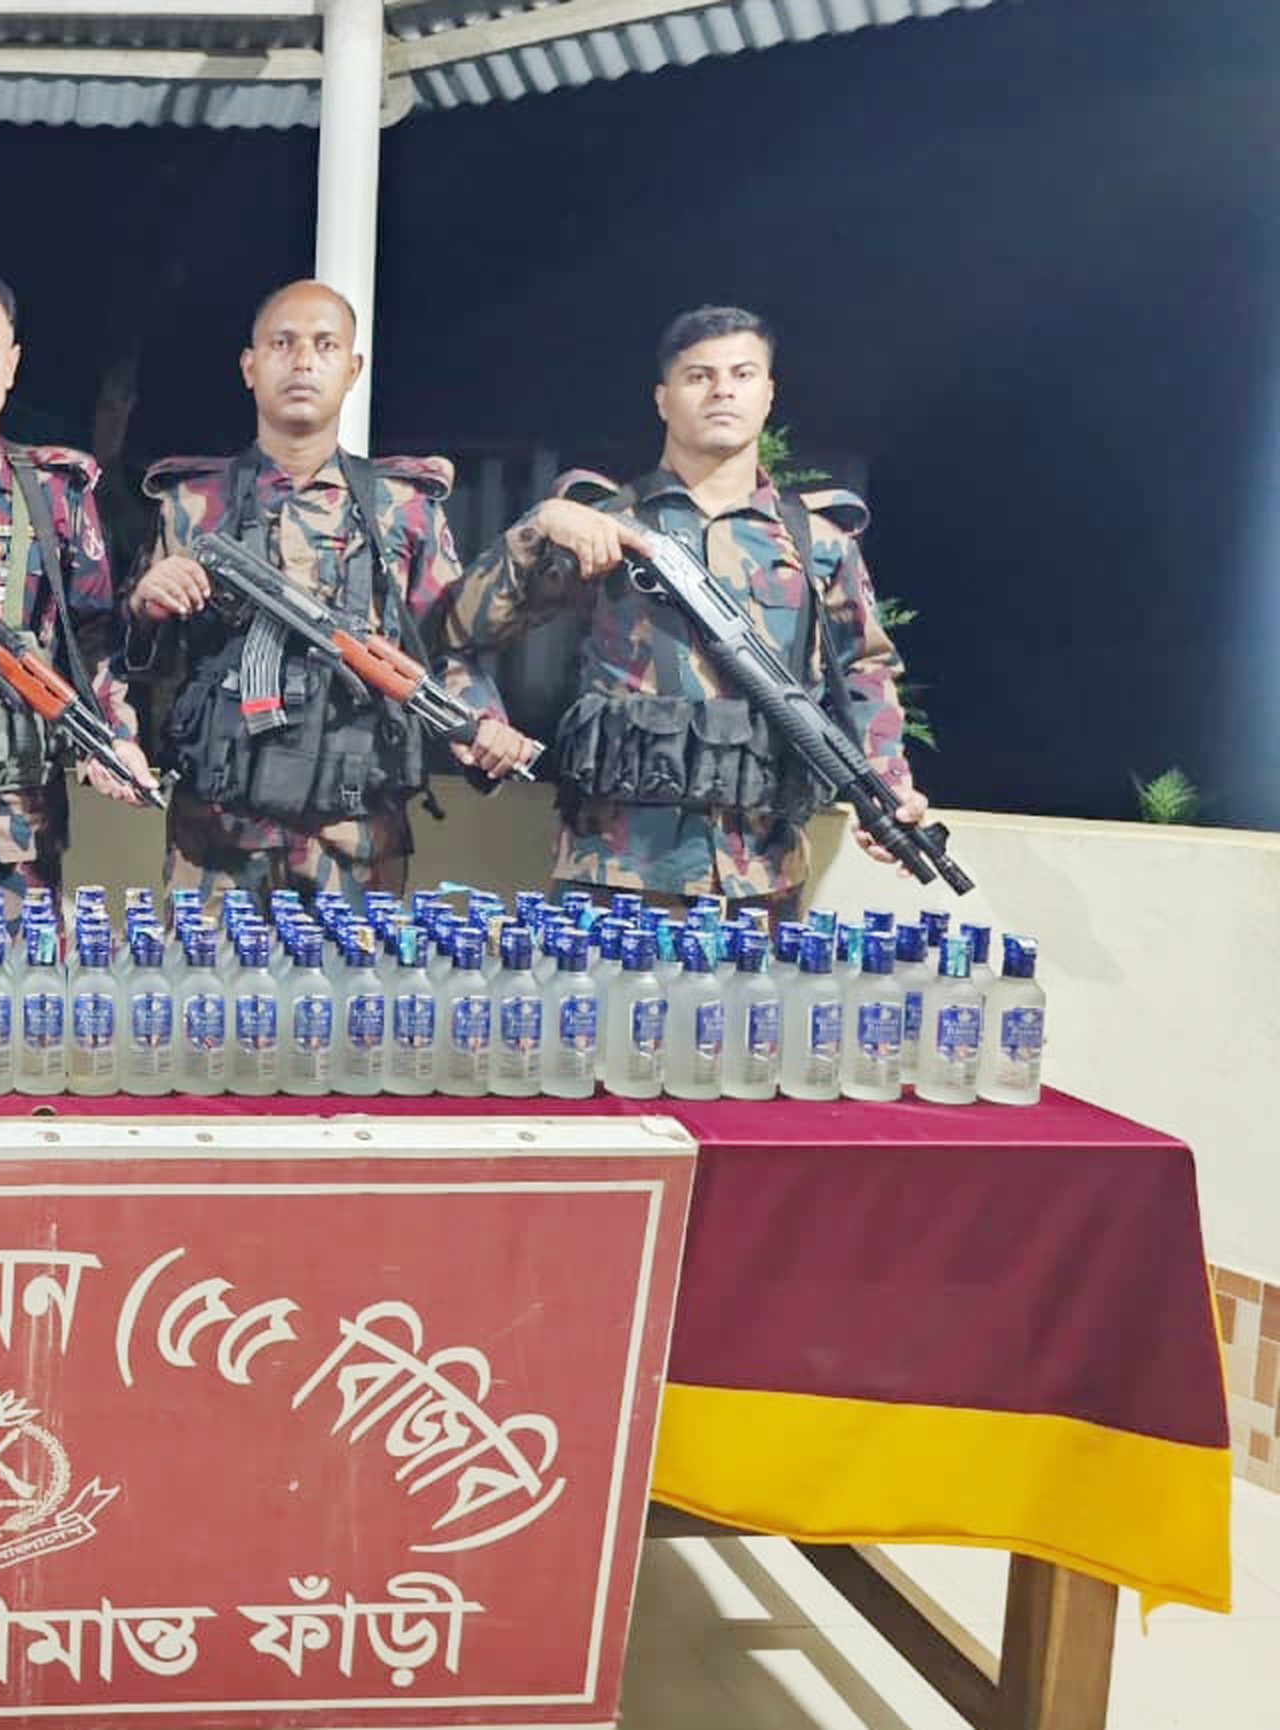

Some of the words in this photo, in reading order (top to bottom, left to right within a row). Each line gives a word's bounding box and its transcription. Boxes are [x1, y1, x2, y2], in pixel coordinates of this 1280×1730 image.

[115, 1247, 300, 1387] (৫৫
[291, 1300, 567, 1553] বিজিবি)
[236, 1571, 485, 1687] ফাঁড়ী
